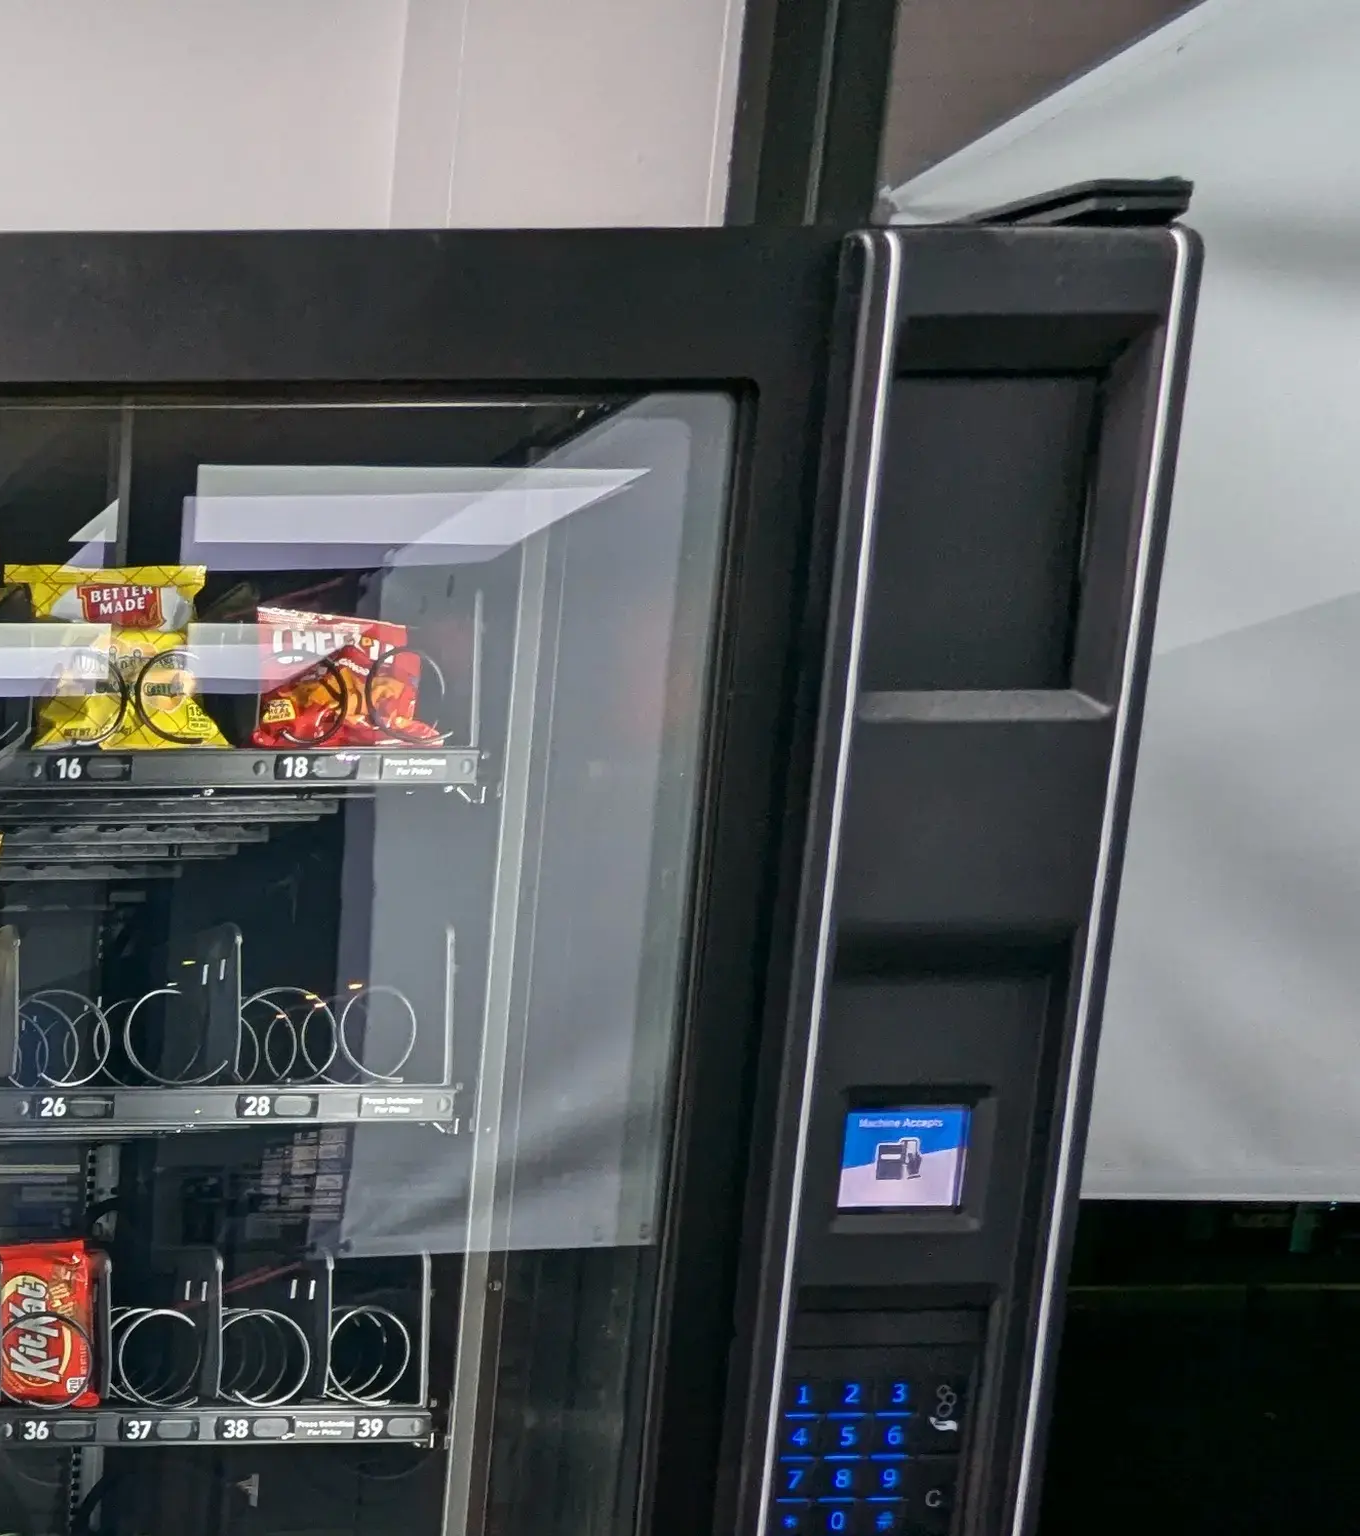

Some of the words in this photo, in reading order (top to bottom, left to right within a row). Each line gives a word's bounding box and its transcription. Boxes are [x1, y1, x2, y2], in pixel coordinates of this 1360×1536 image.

[90, 586, 153, 604] BETTER
[99, 597, 145, 613] MADE
[56, 758, 81, 779] 16
[283, 757, 308, 778] 18
[41, 1099, 66, 1116] 26
[245, 1097, 270, 1116] 28
[798, 1386, 809, 1404] 1
[845, 1384, 861, 1403] 2
[892, 1384, 908, 1403] 3
[24, 1422, 49, 1439] 36
[127, 1421, 151, 1439] 37
[223, 1420, 248, 1438] 38
[358, 1419, 383, 1437] 39
[792, 1428, 807, 1445] 4
[840, 1426, 856, 1445] 5
[888, 1426, 903, 1445] 6
[788, 1471, 802, 1489] 7
[836, 1469, 851, 1488] 8
[884, 1469, 899, 1488] 9
[925, 1490, 941, 1507] C
[831, 1512, 845, 1530] 0
